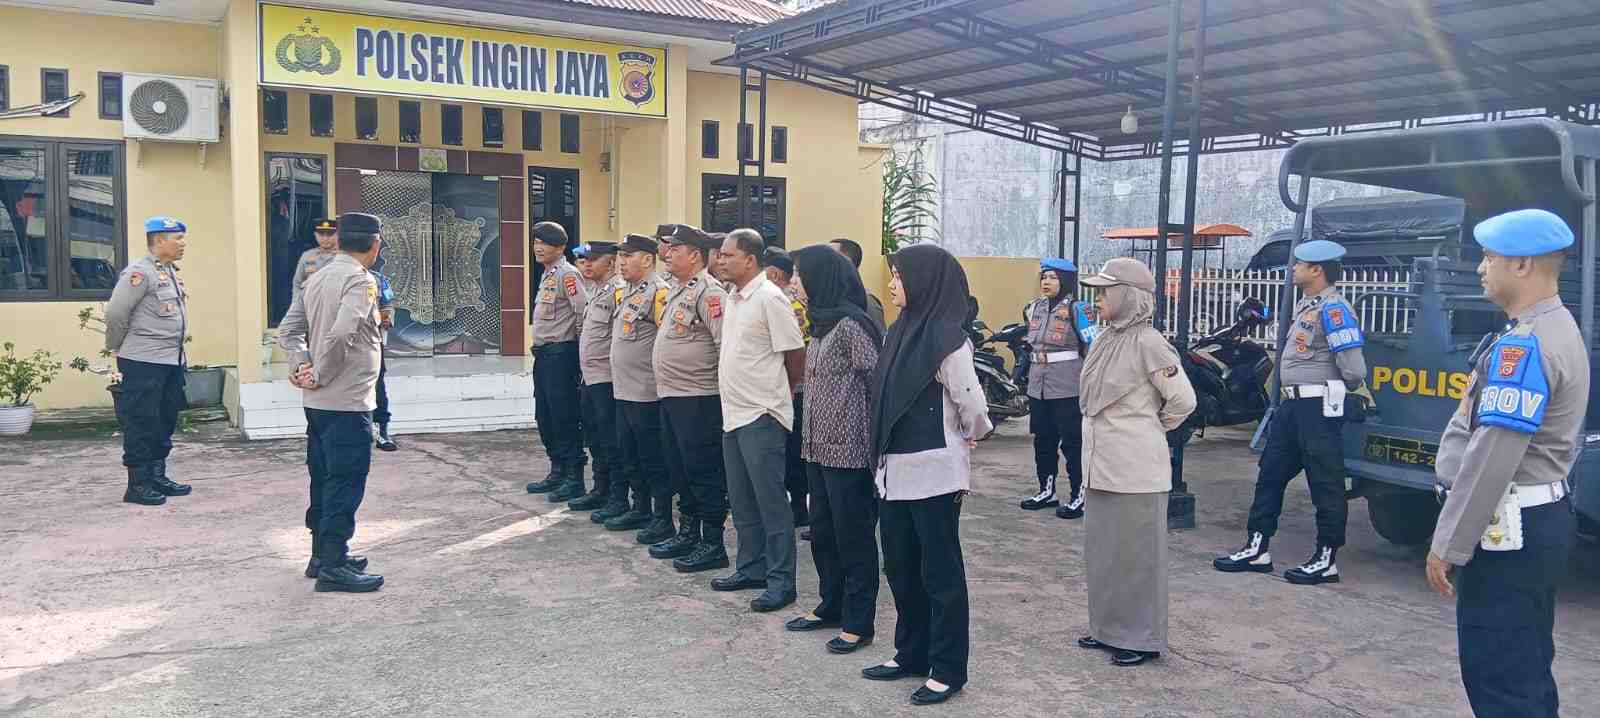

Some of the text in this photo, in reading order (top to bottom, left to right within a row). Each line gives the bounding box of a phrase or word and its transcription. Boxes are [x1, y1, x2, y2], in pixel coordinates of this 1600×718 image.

[356, 28, 610, 98] POLSEK INGIN JAYA
[1372, 366, 1469, 400] POLIS
[1477, 385, 1544, 418] PROV
[1393, 450, 1436, 465] 142-2
